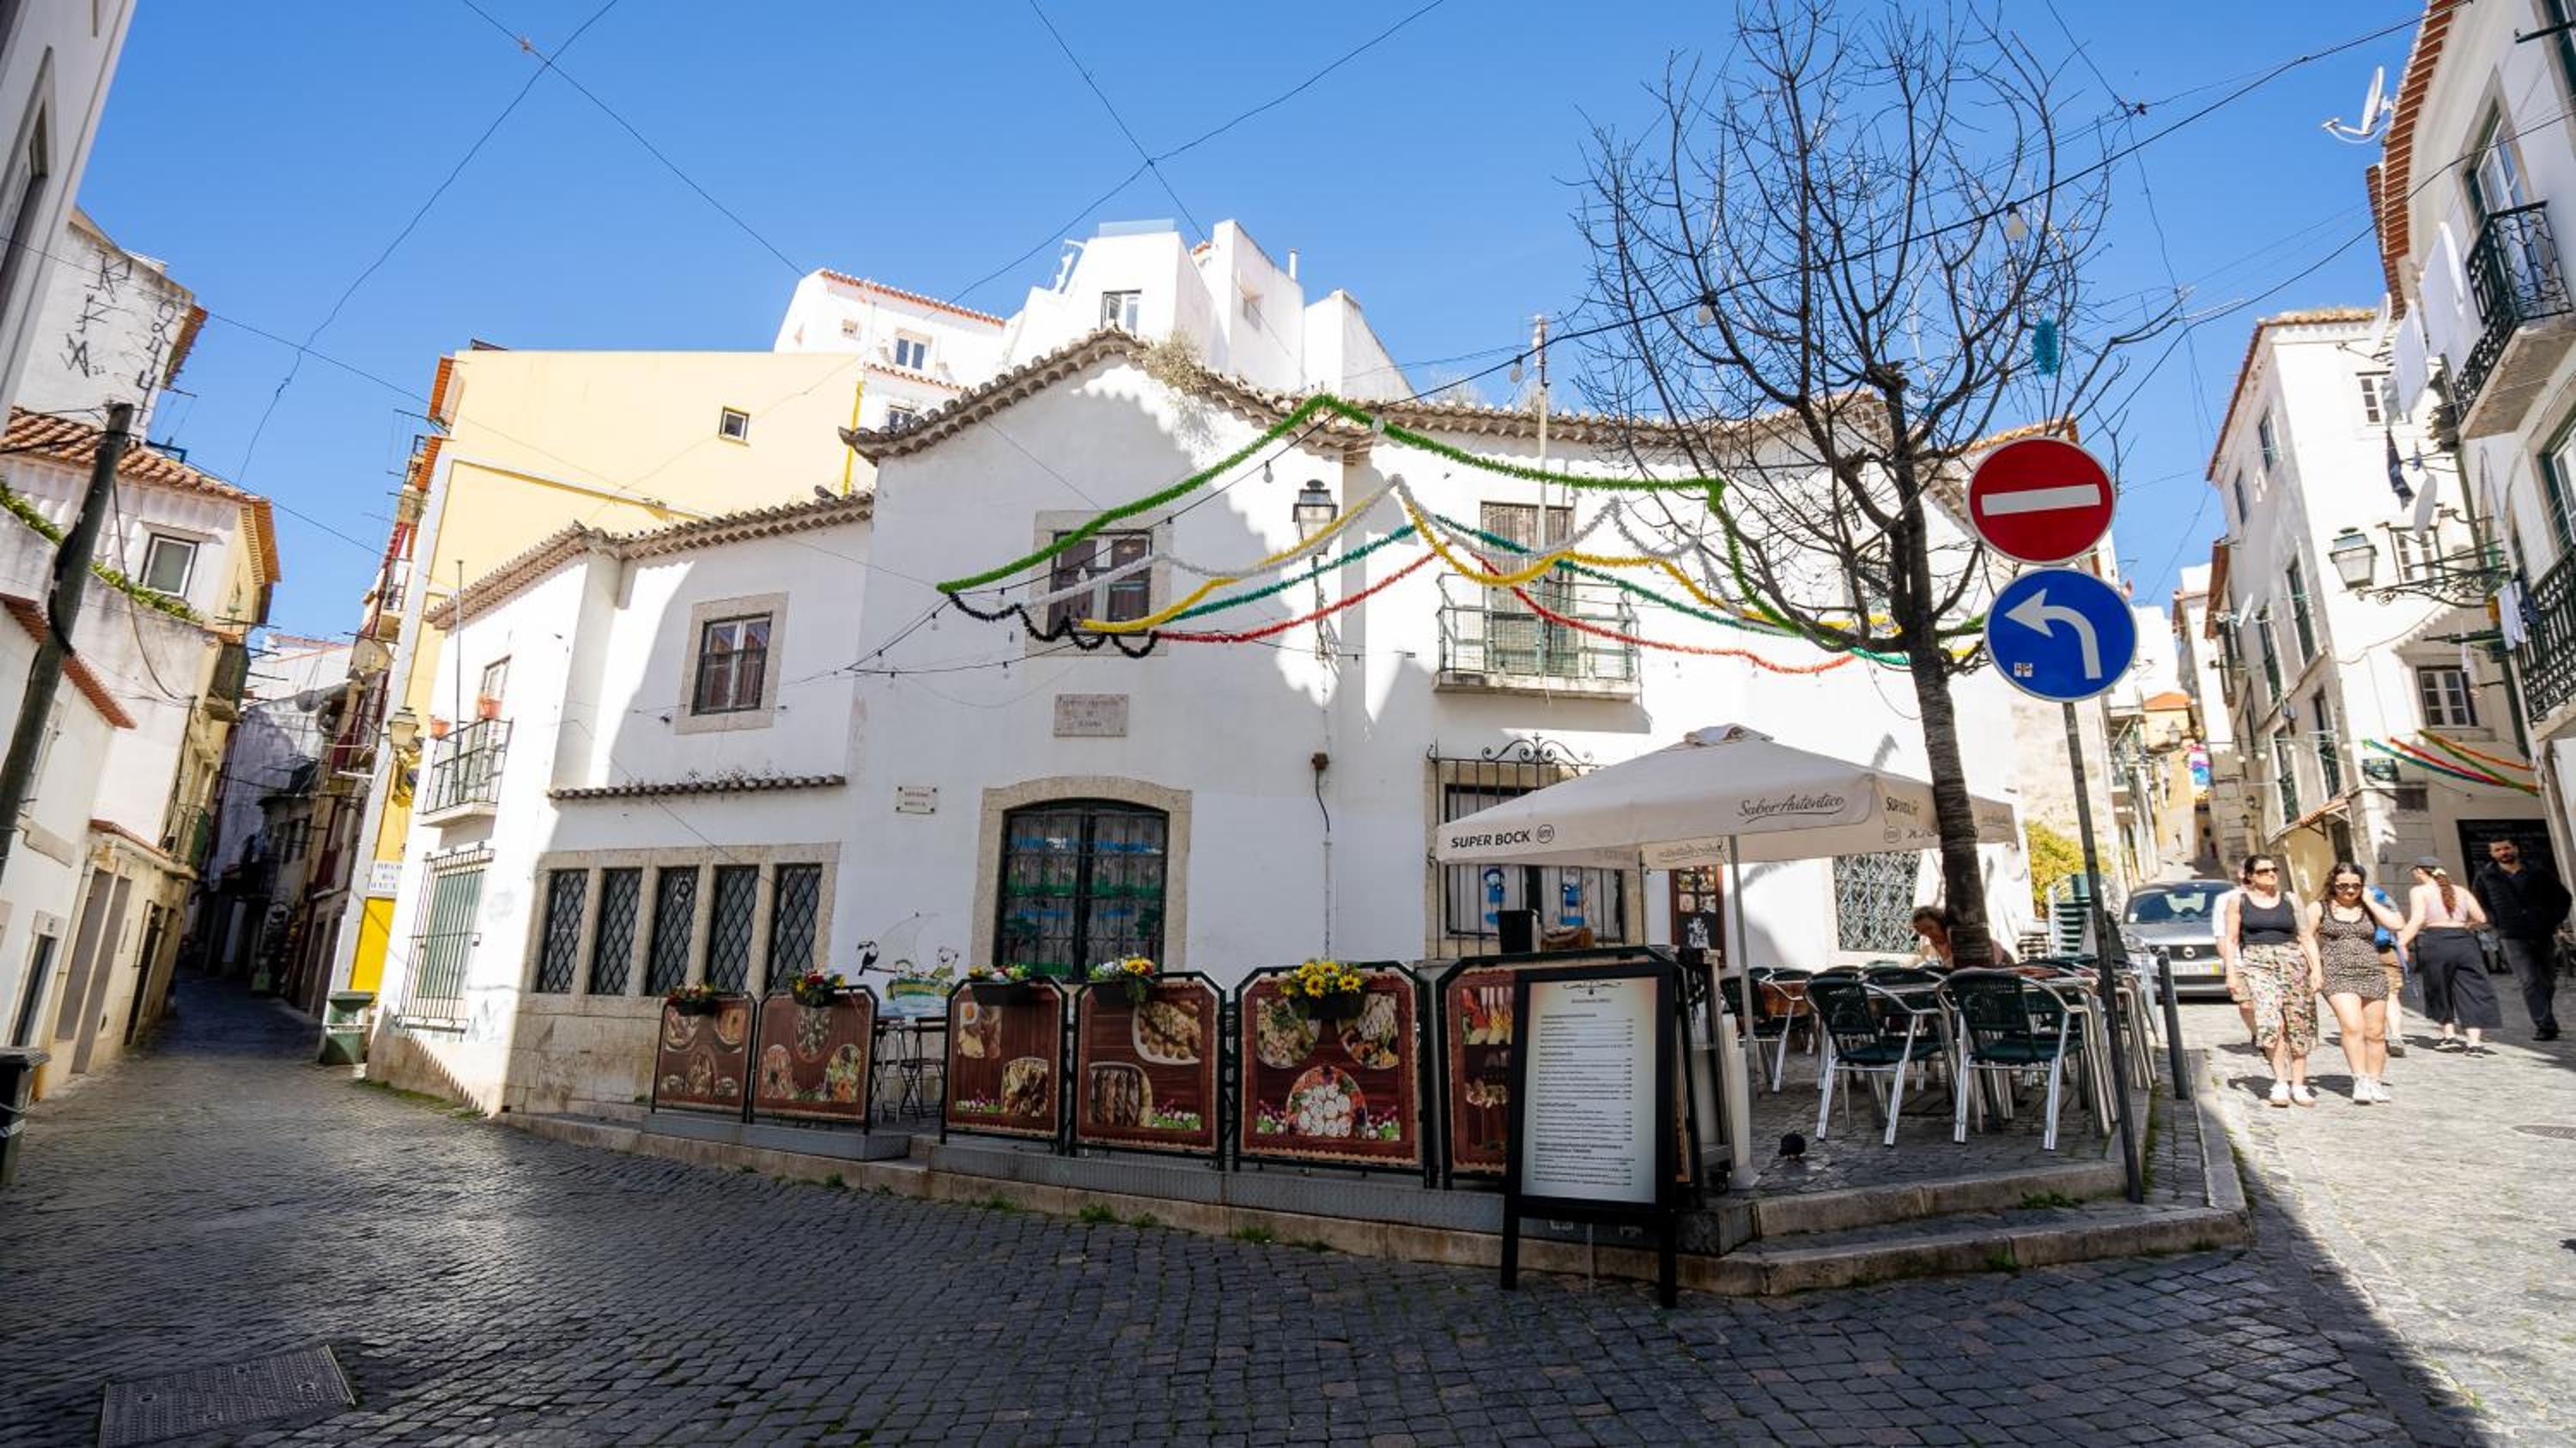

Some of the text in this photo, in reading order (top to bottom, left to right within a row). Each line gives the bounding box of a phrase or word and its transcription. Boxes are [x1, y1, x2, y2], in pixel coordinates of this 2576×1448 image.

[1738, 800, 1779, 816] Sabor
[1451, 834, 1492, 849] SUPER
[1495, 830, 1531, 846] BOCK
